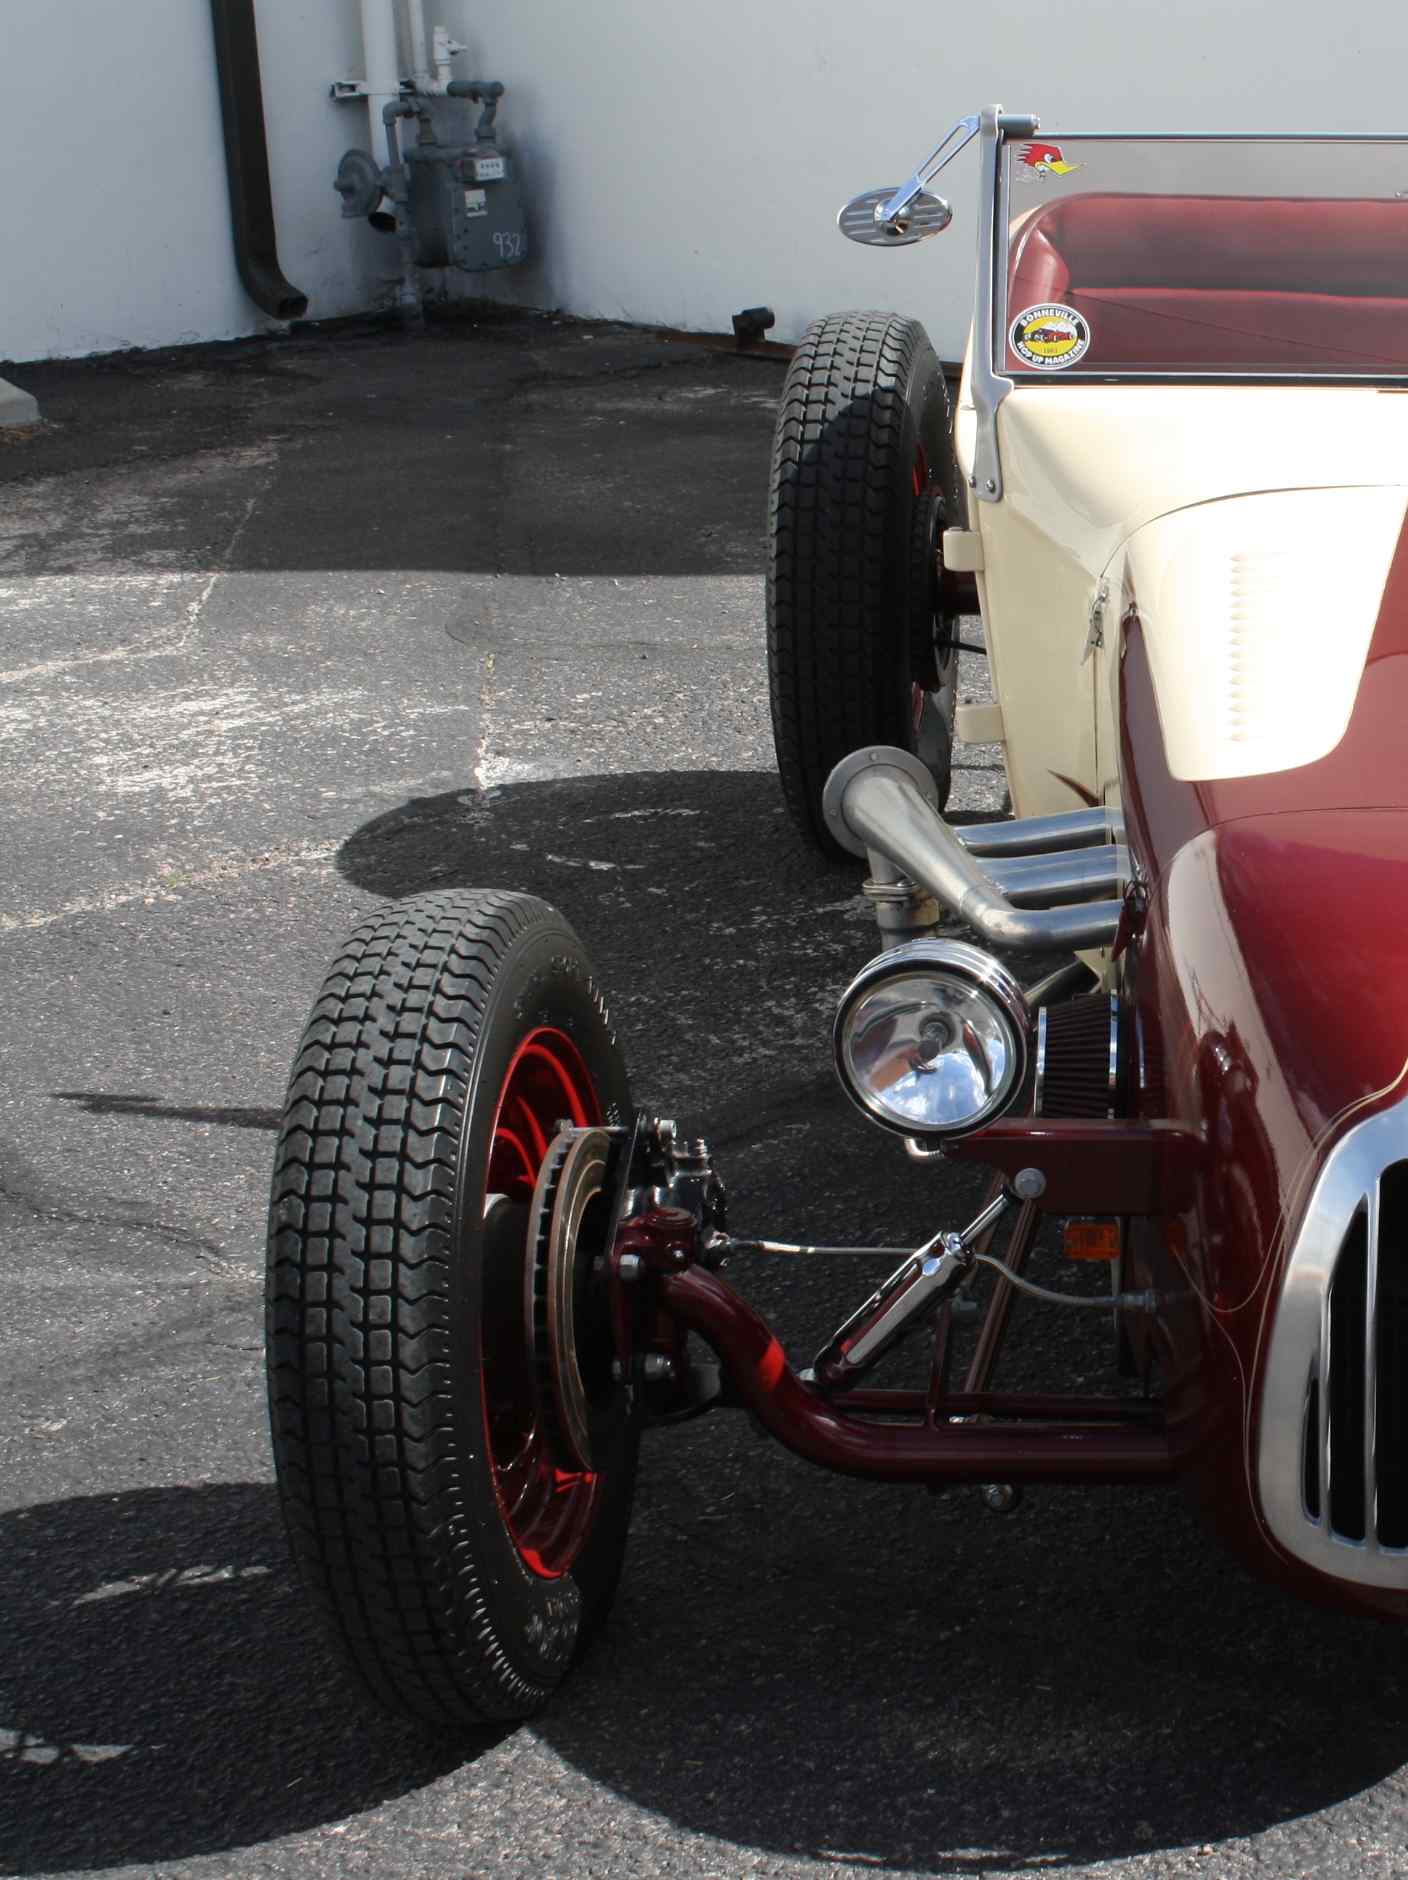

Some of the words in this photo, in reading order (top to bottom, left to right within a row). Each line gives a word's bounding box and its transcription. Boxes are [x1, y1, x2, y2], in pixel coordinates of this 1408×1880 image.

[492, 231, 521, 257] 932
[1020, 308, 1080, 327] BONNEVILLE
[1017, 341, 1033, 358] HOP
[1032, 355, 1044, 364] UP
[1044, 339, 1085, 365] MAGAZINE
